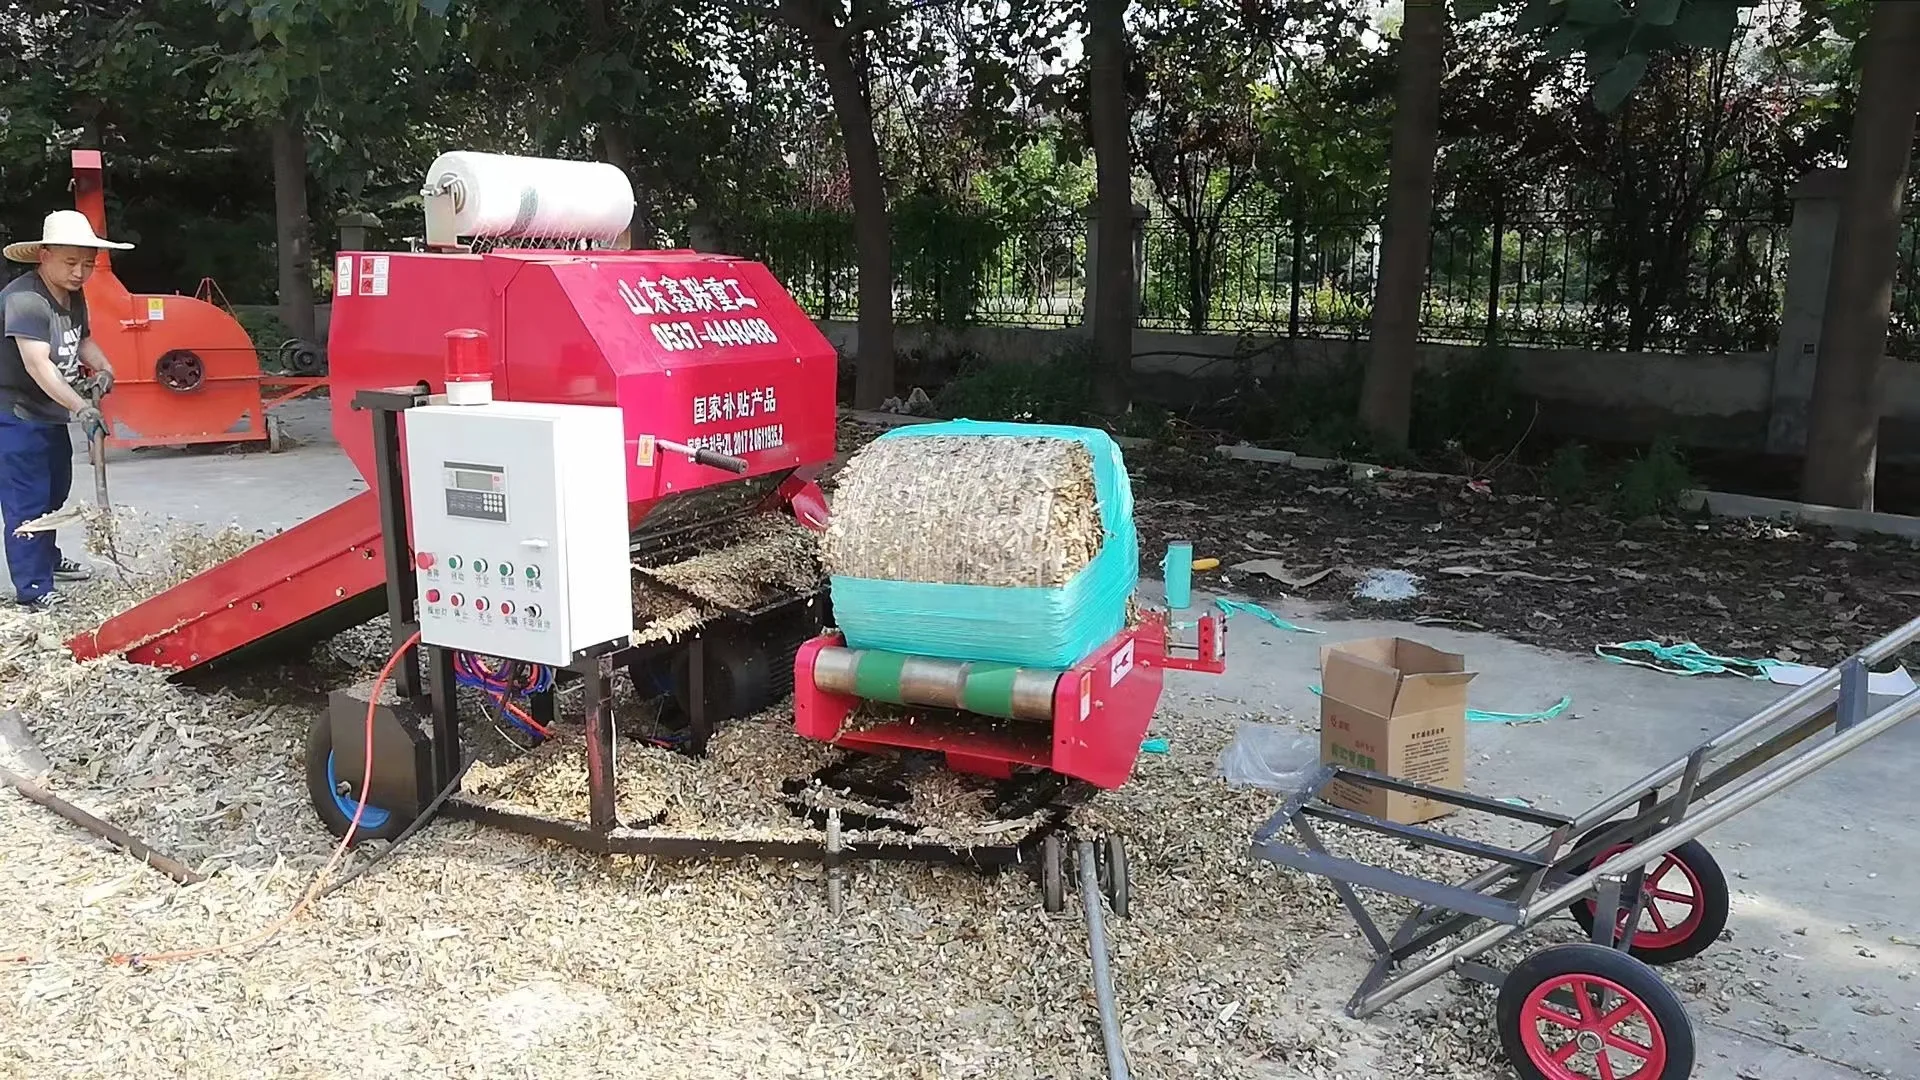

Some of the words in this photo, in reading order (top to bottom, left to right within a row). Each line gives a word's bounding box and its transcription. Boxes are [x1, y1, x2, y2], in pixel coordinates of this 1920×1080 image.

[617, 274, 758, 315] 山东鑫联重工
[694, 386, 777, 425] 国家补贴产品
